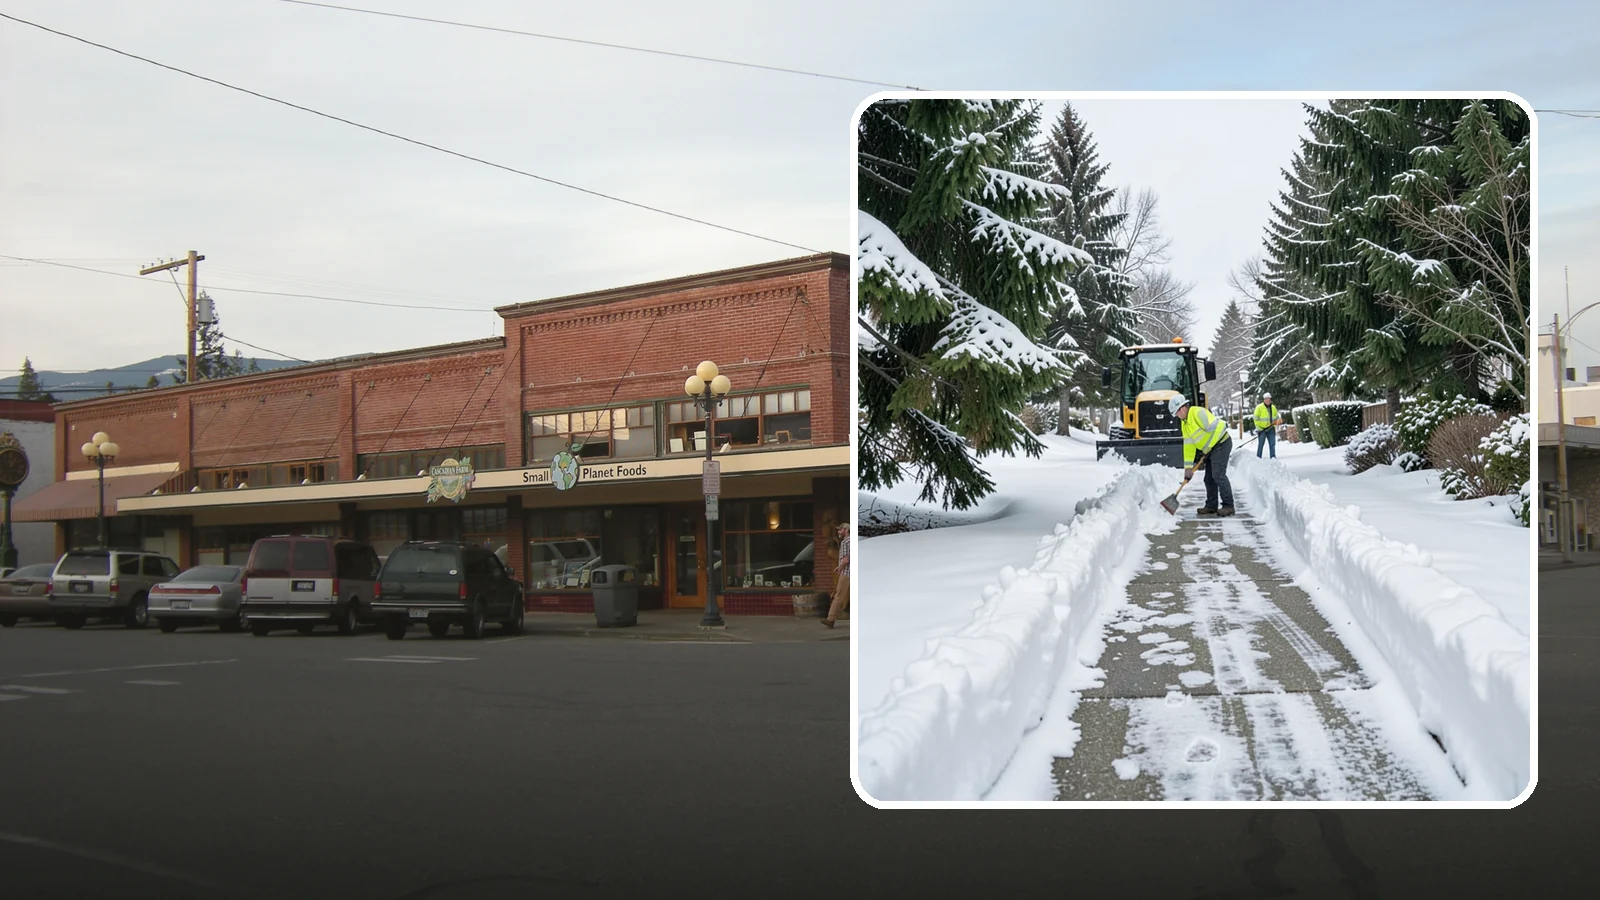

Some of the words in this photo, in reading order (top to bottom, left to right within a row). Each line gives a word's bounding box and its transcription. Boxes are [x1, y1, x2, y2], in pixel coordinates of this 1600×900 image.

[523, 471, 549, 483] Small
[583, 467, 614, 479] Planet
[617, 464, 647, 477] Foods
